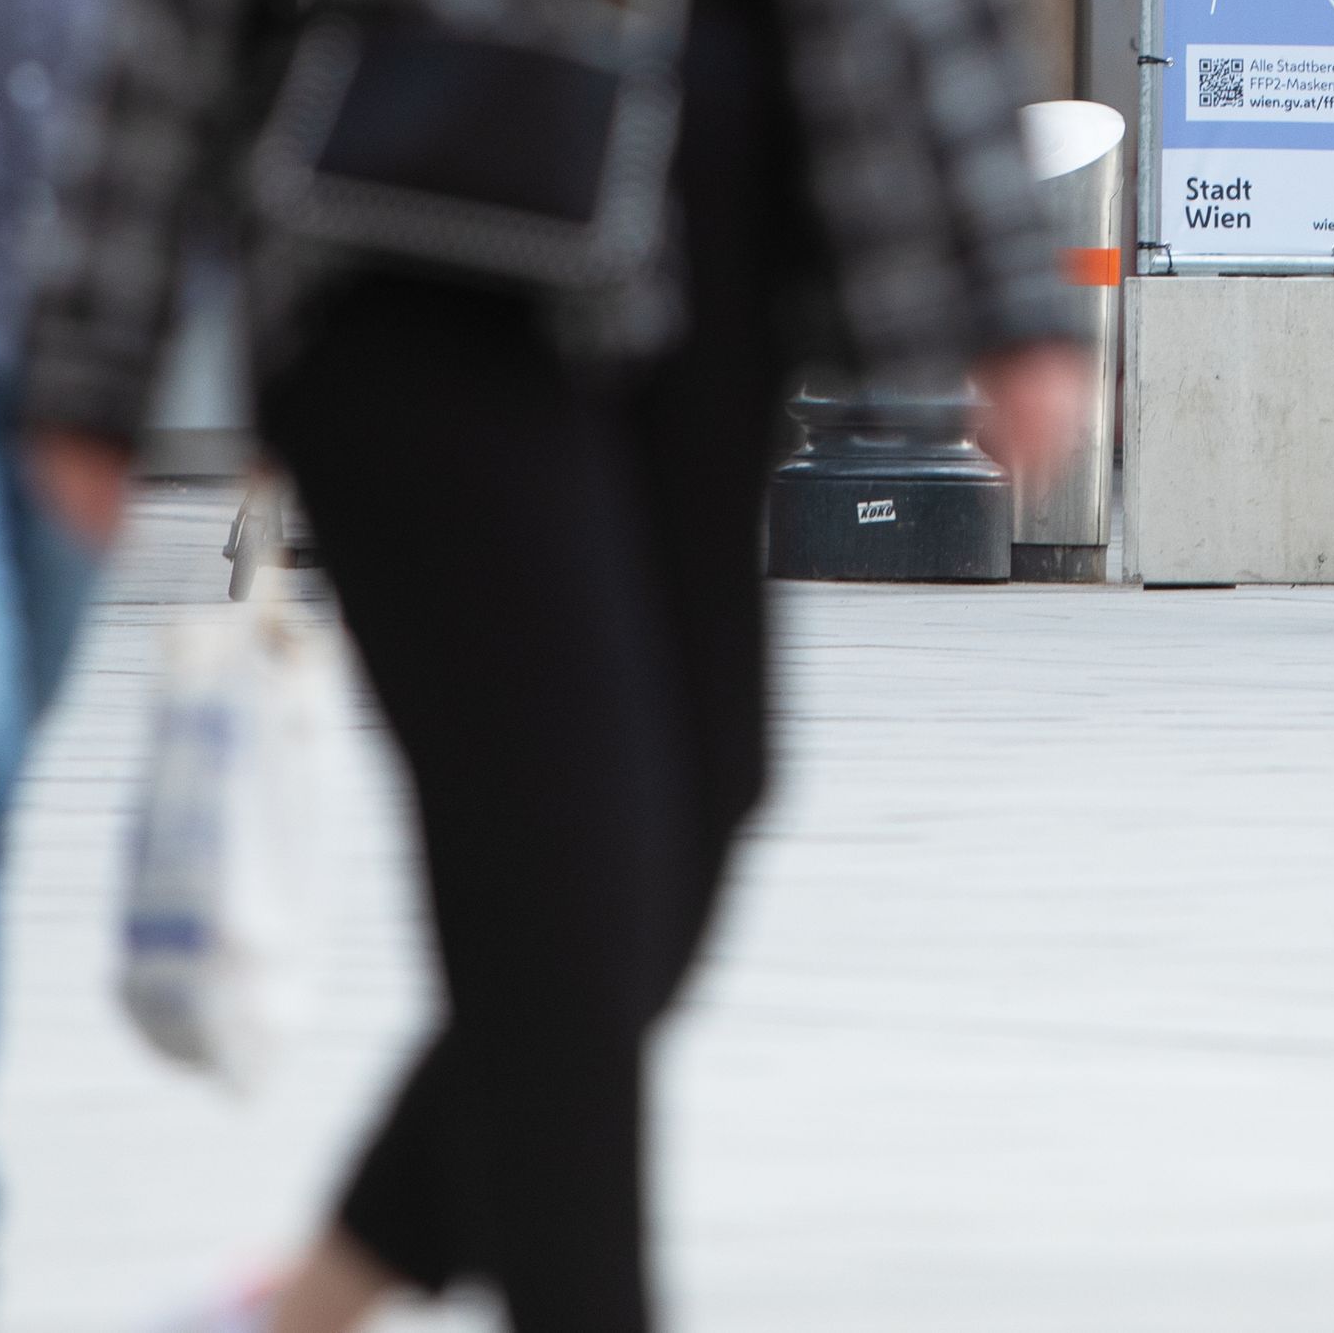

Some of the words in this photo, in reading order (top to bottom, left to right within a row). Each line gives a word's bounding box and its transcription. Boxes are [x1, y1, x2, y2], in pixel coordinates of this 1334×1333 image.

[1250, 59, 1273, 73] Alle
[1186, 177, 1252, 201] Stadt
[1185, 206, 1251, 229] Wien
